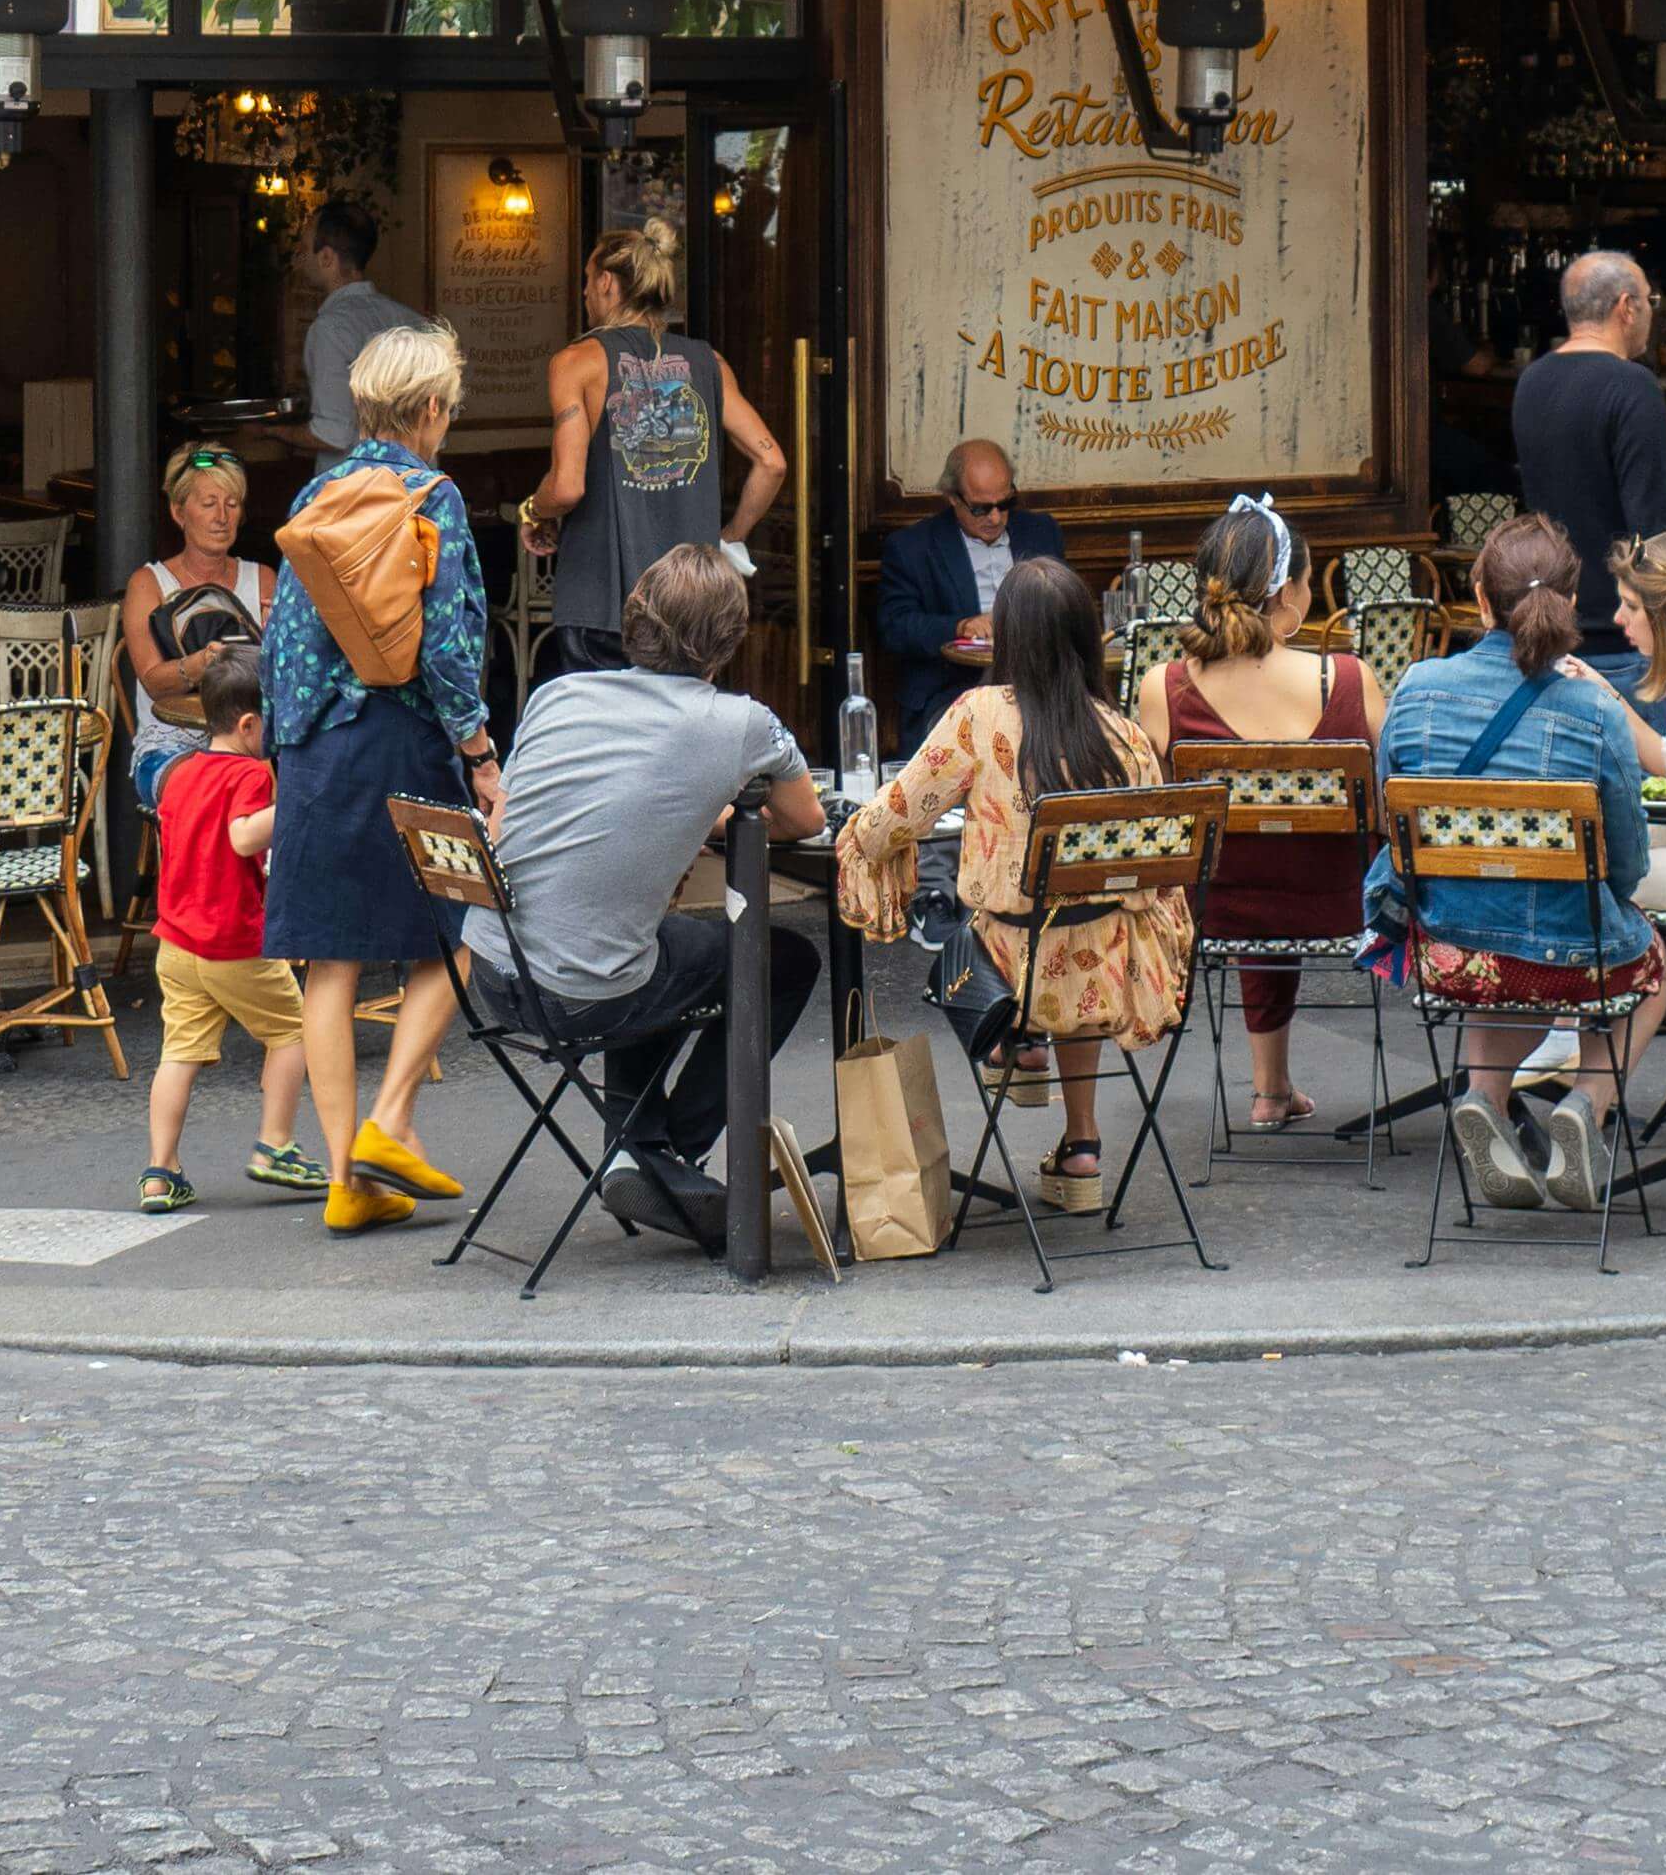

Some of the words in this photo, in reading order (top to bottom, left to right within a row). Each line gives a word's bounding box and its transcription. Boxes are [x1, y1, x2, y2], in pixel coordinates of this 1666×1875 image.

[978, 68, 1293, 160] Restauon
[1029, 189, 1162, 253] PRODUITS
[1170, 190, 1244, 246] FRAIS
[1126, 239, 1150, 280] &
[1030, 277, 1107, 341] FAIT
[1115, 274, 1240, 343] MAISON
[1019, 344, 1153, 402] TOUTE
[1163, 318, 1287, 399] HEURE
